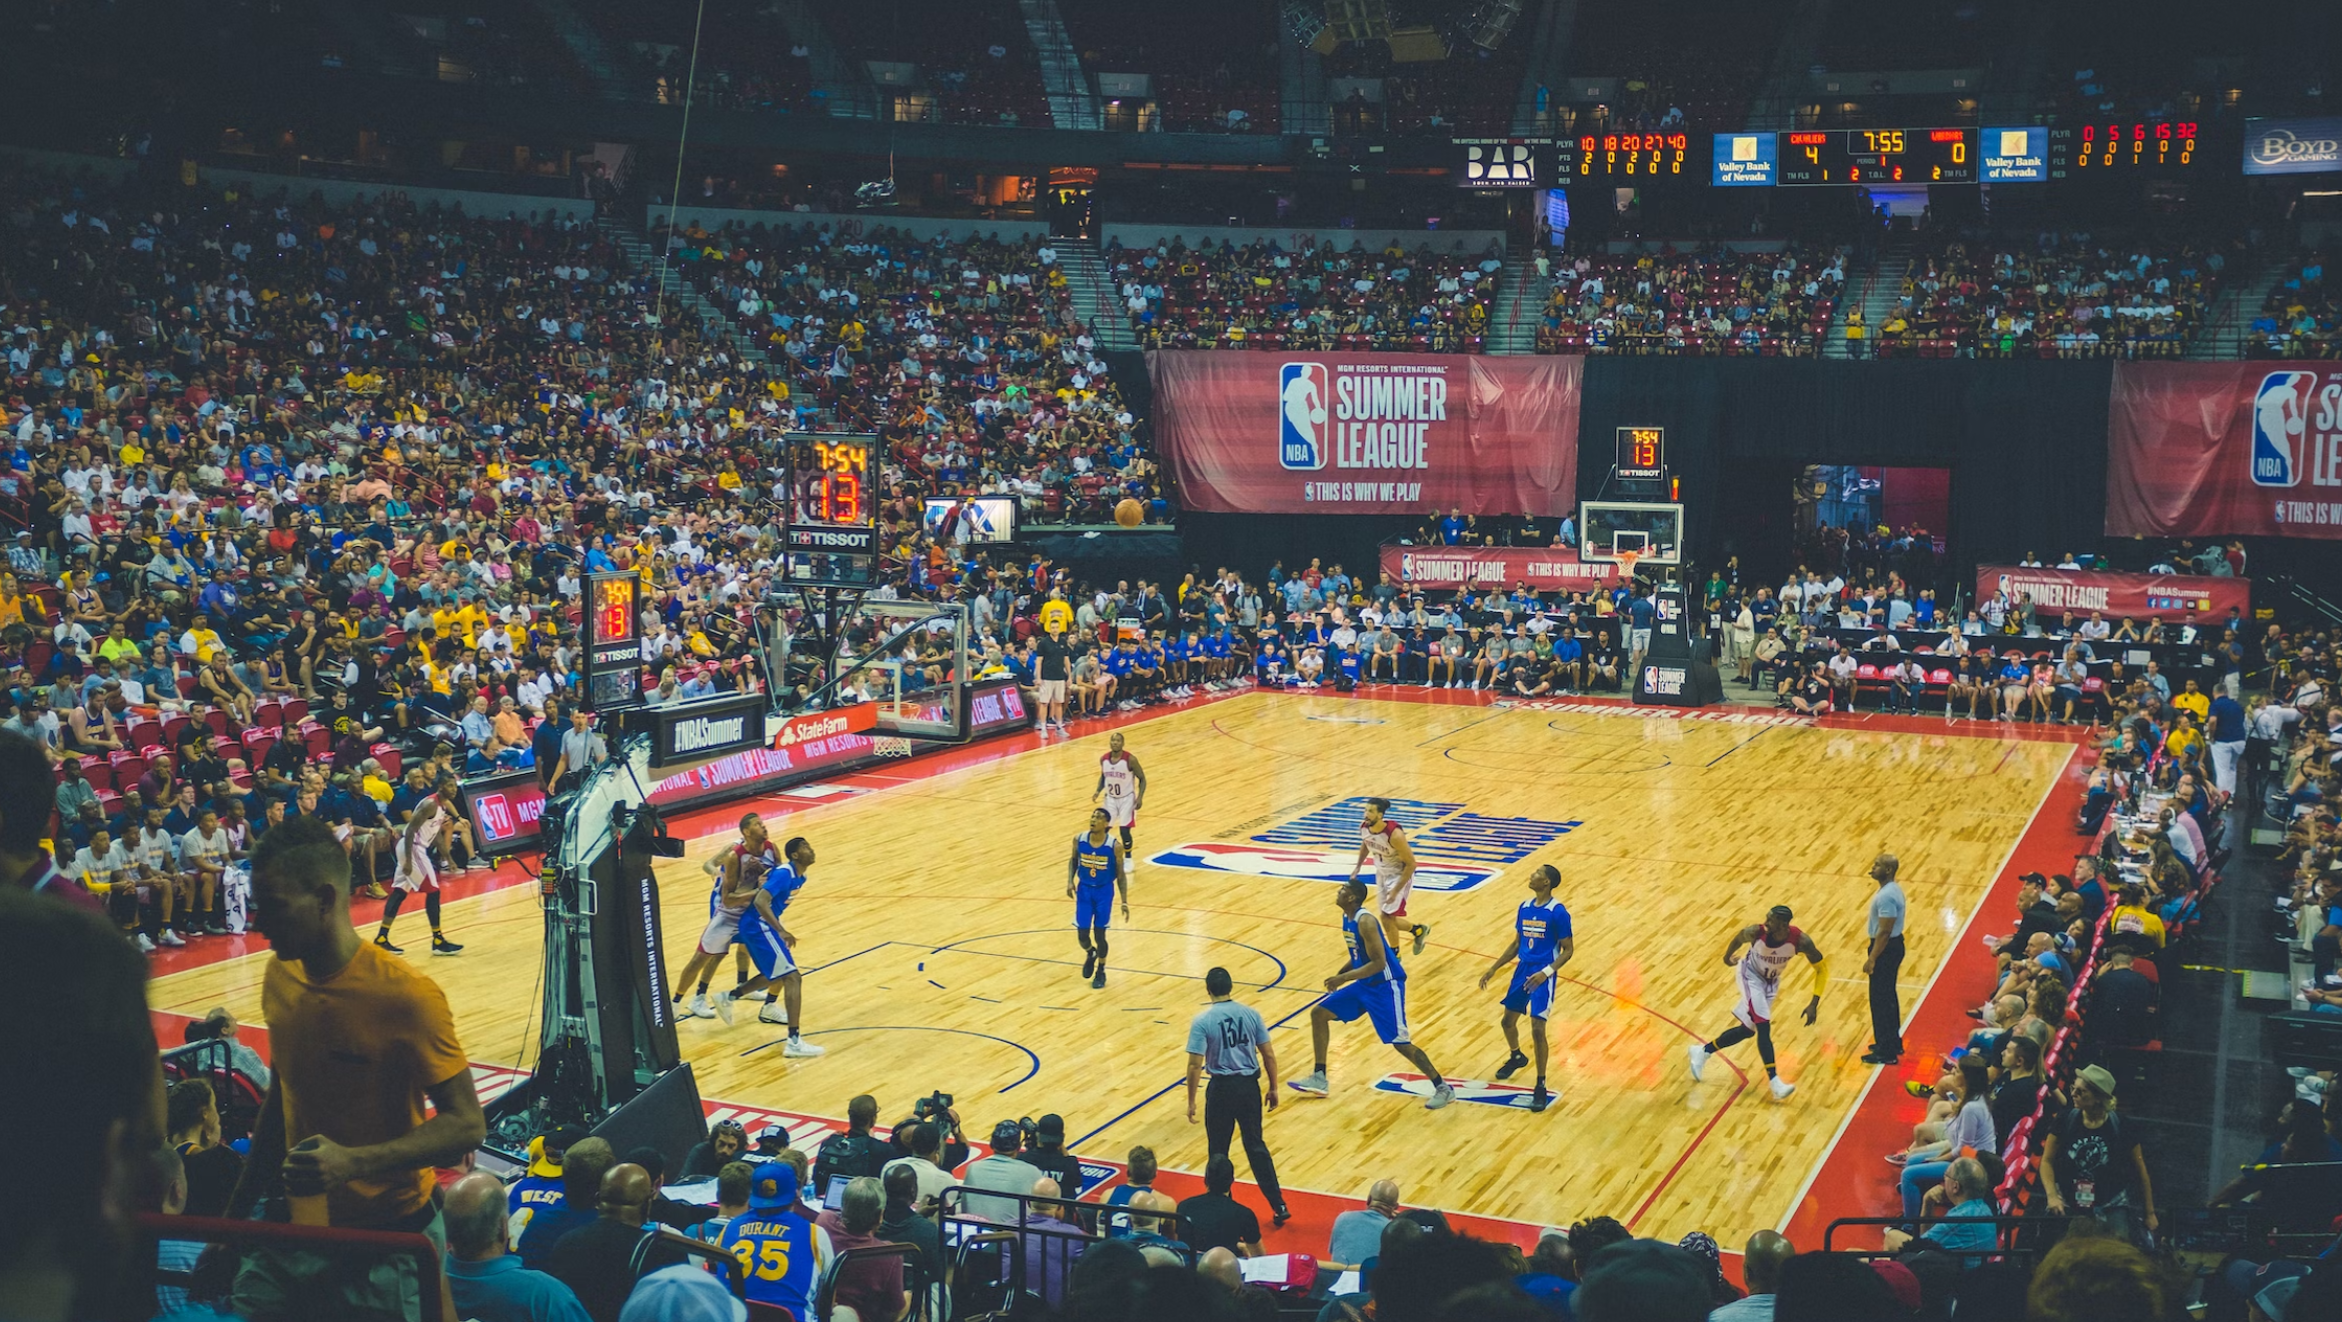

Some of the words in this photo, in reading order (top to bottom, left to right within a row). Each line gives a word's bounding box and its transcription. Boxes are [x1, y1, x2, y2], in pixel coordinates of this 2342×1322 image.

[2083, 125, 2094, 141] 0
[2109, 125, 2120, 141] 5
[2134, 124, 2145, 140] 6
[2155, 123, 2171, 139] 15
[2177, 123, 2198, 139] 32
[1556, 140, 1574, 149] PLYR
[1581, 136, 1595, 151] 10
[1604, 136, 1617, 150] 18
[1622, 136, 1640, 150] 20
[1645, 136, 1663, 149] 27
[1667, 135, 1686, 149] 40
[1864, 130, 1903, 152] 7:55
[2083, 142, 2092, 154] 0
[2108, 141, 2117, 153] 0
[2134, 141, 2142, 152] 0
[2160, 140, 2168, 152] 0
[2186, 139, 2194, 151] 0
[1585, 153, 1592, 163] 2
[1608, 152, 1615, 163] 0
[1631, 152, 1638, 163] 2
[1653, 150, 1661, 162] 0
[1676, 150, 1684, 162] 0
[1806, 146, 1818, 164] 4
[1880, 155, 1886, 166] 1
[1952, 143, 1965, 163] 0
[2078, 154, 2088, 166] 0
[2104, 154, 2113, 166] 0
[2134, 154, 2138, 164] 1
[2160, 153, 2164, 163] 1
[2181, 152, 2190, 164] 0
[2288, 152, 2337, 161] GAMING
[1581, 164, 1589, 175] 0
[1608, 164, 1612, 173] 1
[1626, 163, 1634, 174] 0
[1649, 163, 1657, 174] 0
[1672, 162, 1680, 174] 0
[1718, 162, 1743, 172] Valley
[1745, 161, 1770, 170] Bank
[1985, 157, 2011, 168] Valley
[2015, 156, 2041, 166] Bank
[1722, 172, 1731, 181] of
[1733, 172, 1766, 181] Nevada
[1823, 169, 1828, 180] 1
[1851, 167, 1859, 181] 2
[1894, 166, 1902, 180] 2
[1932, 165, 1940, 179] 2
[1989, 168, 2000, 178] of
[2001, 167, 2037, 178] Nevada
[1337, 365, 1355, 373] MGM
[1357, 365, 1389, 373] RESORTS
[1390, 365, 1448, 374] INTERNATIONAL
[1336, 376, 1447, 422] SUMMER
[1632, 430, 1659, 444] 7:54
[1285, 443, 1309, 462] NBA
[1337, 422, 1429, 469] LEAGUE
[815, 443, 866, 473] 7:54
[1635, 444, 1655, 466] 13
[2258, 458, 2281, 477] NBA
[821, 475, 859, 522] 13
[1316, 482, 1340, 501] THIS
[1342, 482, 1352, 501] IS
[1354, 482, 1377, 501] WHY
[1379, 482, 1395, 501] WE
[1396, 482, 1421, 501] PLAY
[2287, 502, 2313, 524] THIS
[2315, 503, 2328, 524] IS
[811, 533, 870, 547] TISSOT
[1415, 561, 1464, 581] SUMMER
[1466, 561, 1506, 582] LEAGUE
[1535, 563, 1551, 577] THIS
[1553, 563, 1560, 577] IS
[1562, 563, 1579, 577] WHY
[1580, 563, 1591, 577] WE
[1592, 564, 1610, 578] PLAY
[2066, 585, 2109, 610] LEAGUE
[2147, 586, 2210, 598] #NBASummer
[608, 607, 625, 637] 13
[607, 648, 639, 661] TISSOT
[1659, 670, 1685, 684] SUMMER
[1658, 682, 1681, 695] LEAGUE
[1523, 702, 1675, 719] SUMMER
[1680, 711, 1818, 727] LEAGUE
[674, 715, 744, 753] #NBASummer
[708, 751, 756, 785] SUMMER
[753, 748, 794, 777] LEAGUE
[803, 741, 827, 759] MGM
[828, 734, 867, 754] RESORTS
[1108, 783, 1121, 795] 20
[490, 803, 508, 829] TV
[1090, 868, 1097, 878] 6
[641, 879, 649, 903] MGM
[644, 905, 654, 948] RESORTS
[1528, 938, 1534, 949] 0
[648, 951, 663, 1027] INTERNATIONAL
[1218, 1016, 1249, 1049] 134
[521, 1189, 564, 1205] WEST
[739, 1222, 791, 1239] DURANT
[726, 1240, 792, 1282] 35
